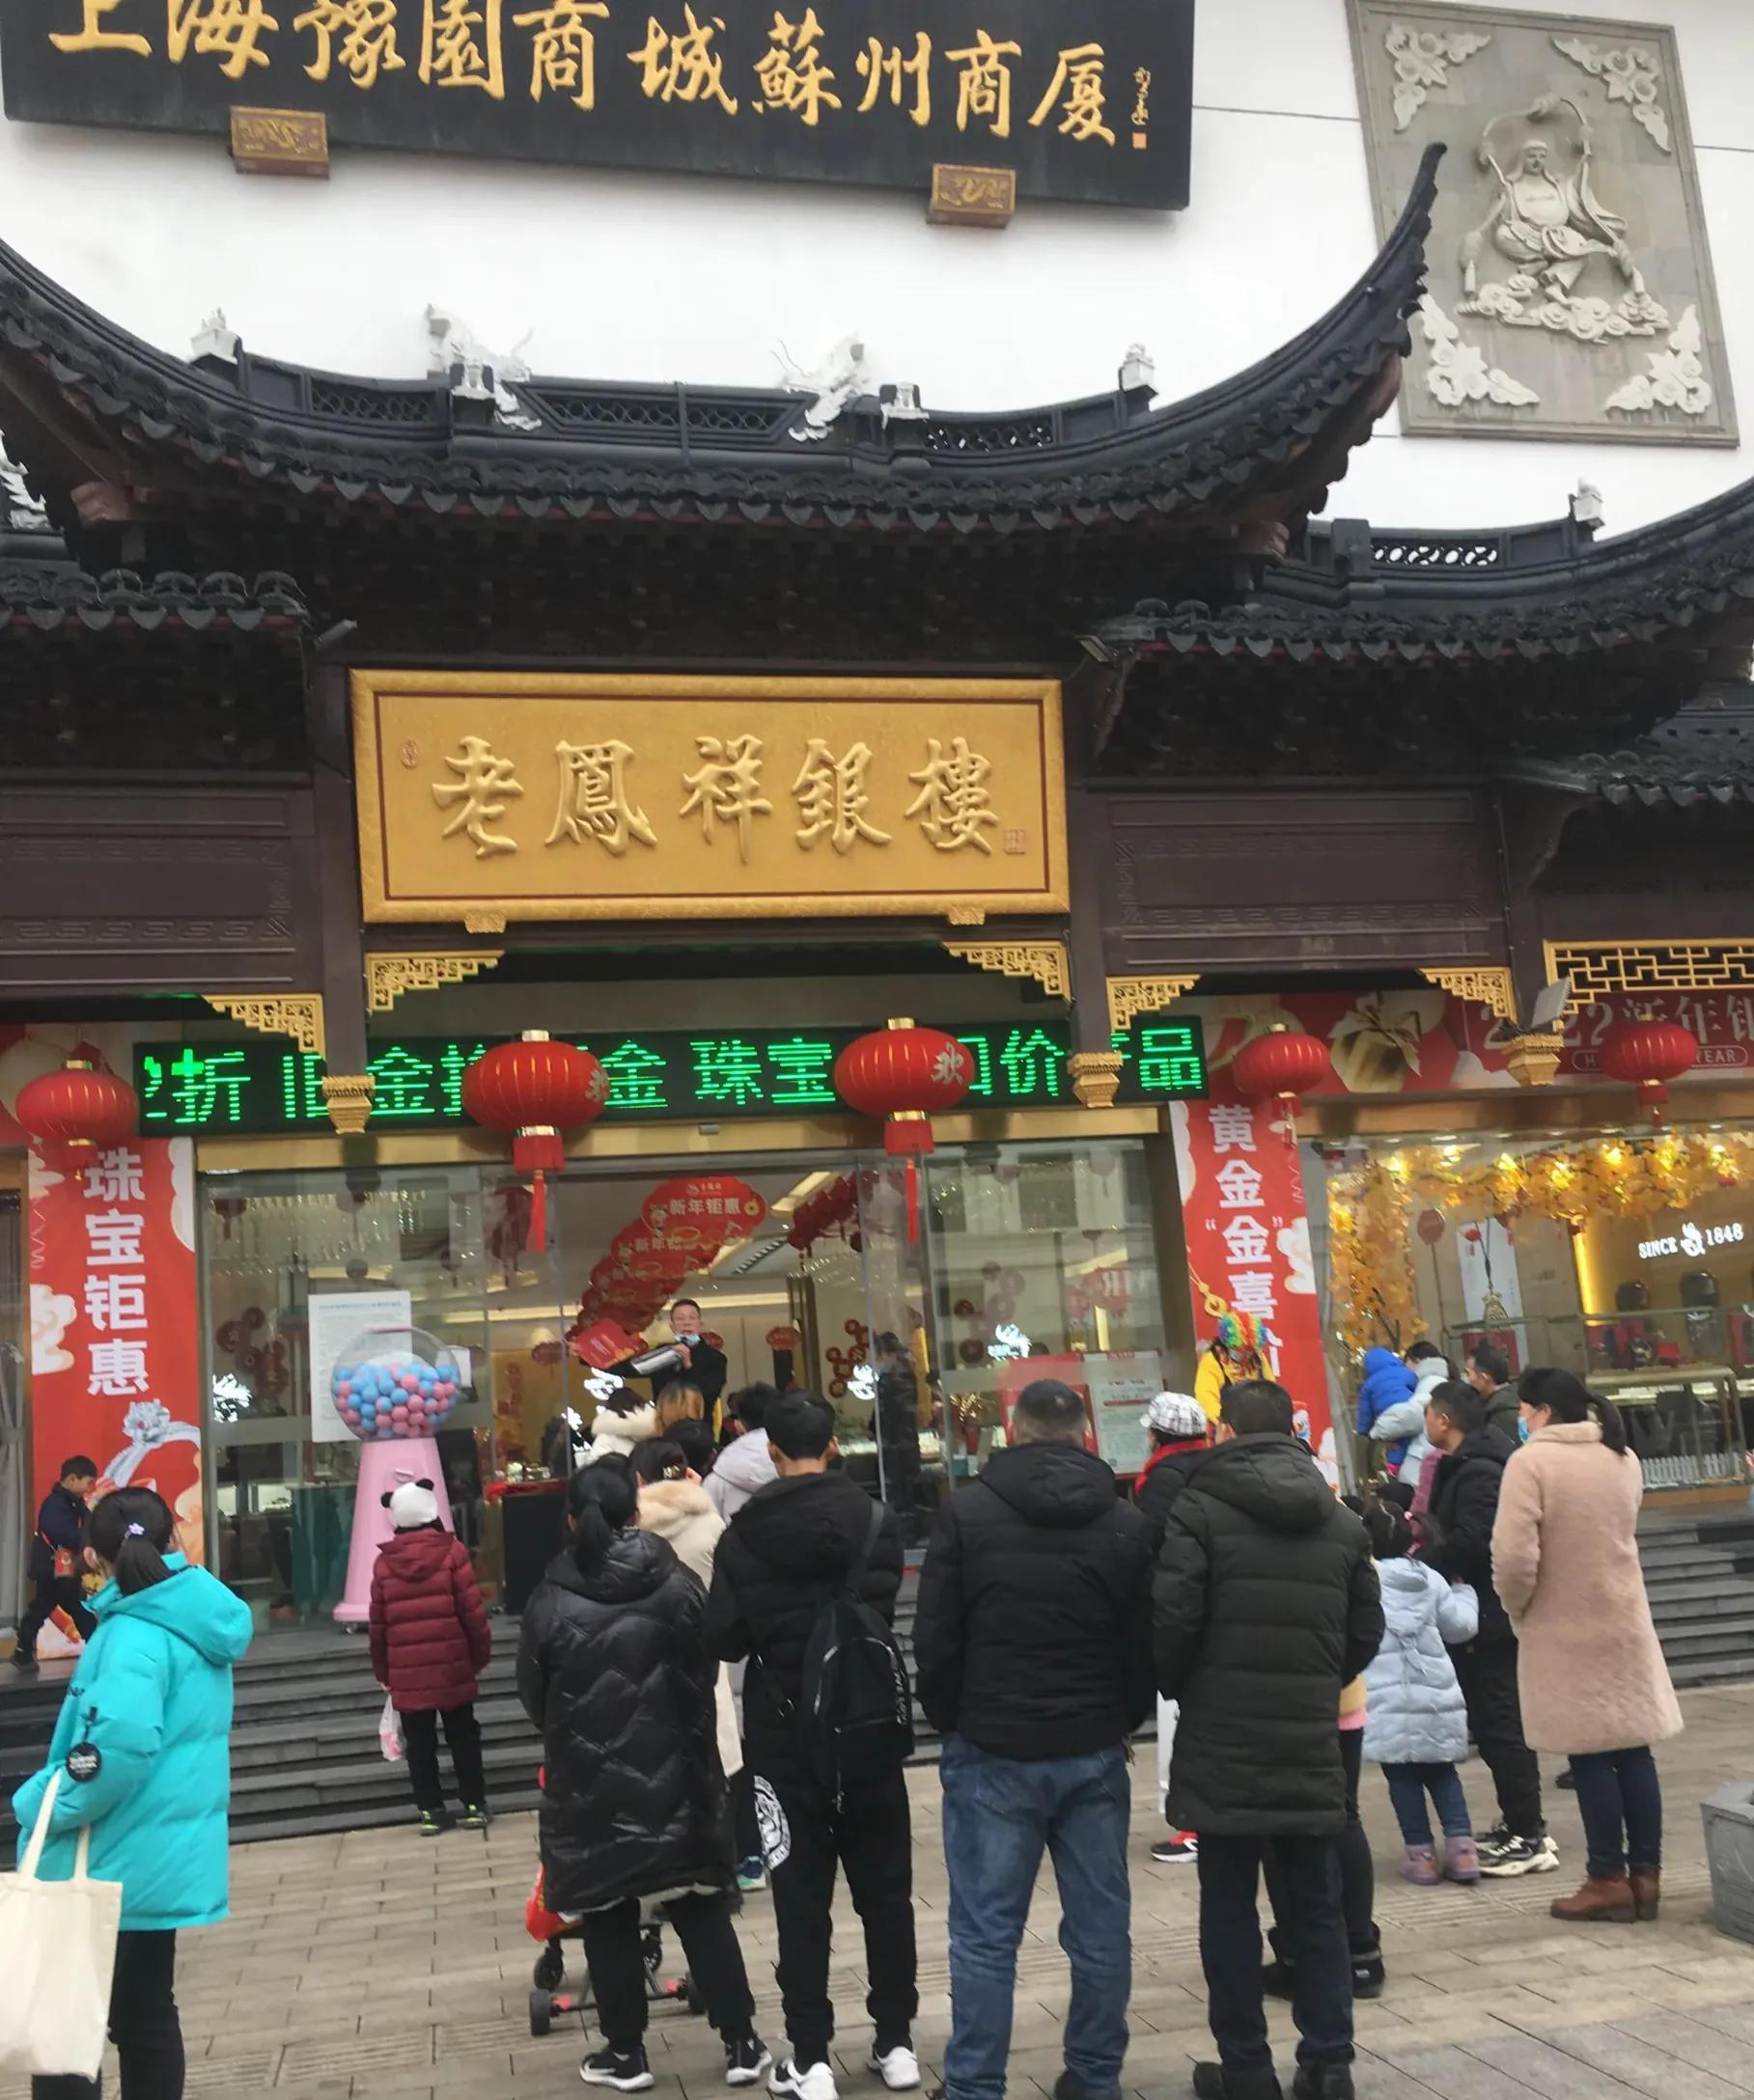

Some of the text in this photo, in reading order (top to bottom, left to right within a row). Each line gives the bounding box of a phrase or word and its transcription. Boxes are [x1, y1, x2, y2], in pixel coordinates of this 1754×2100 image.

[432, 734, 1000, 863] 老鳳祥銀樓
[83, 1147, 150, 1396] 珠宝钜惠
[1638, 1223, 1743, 1258] SINCE 1848
